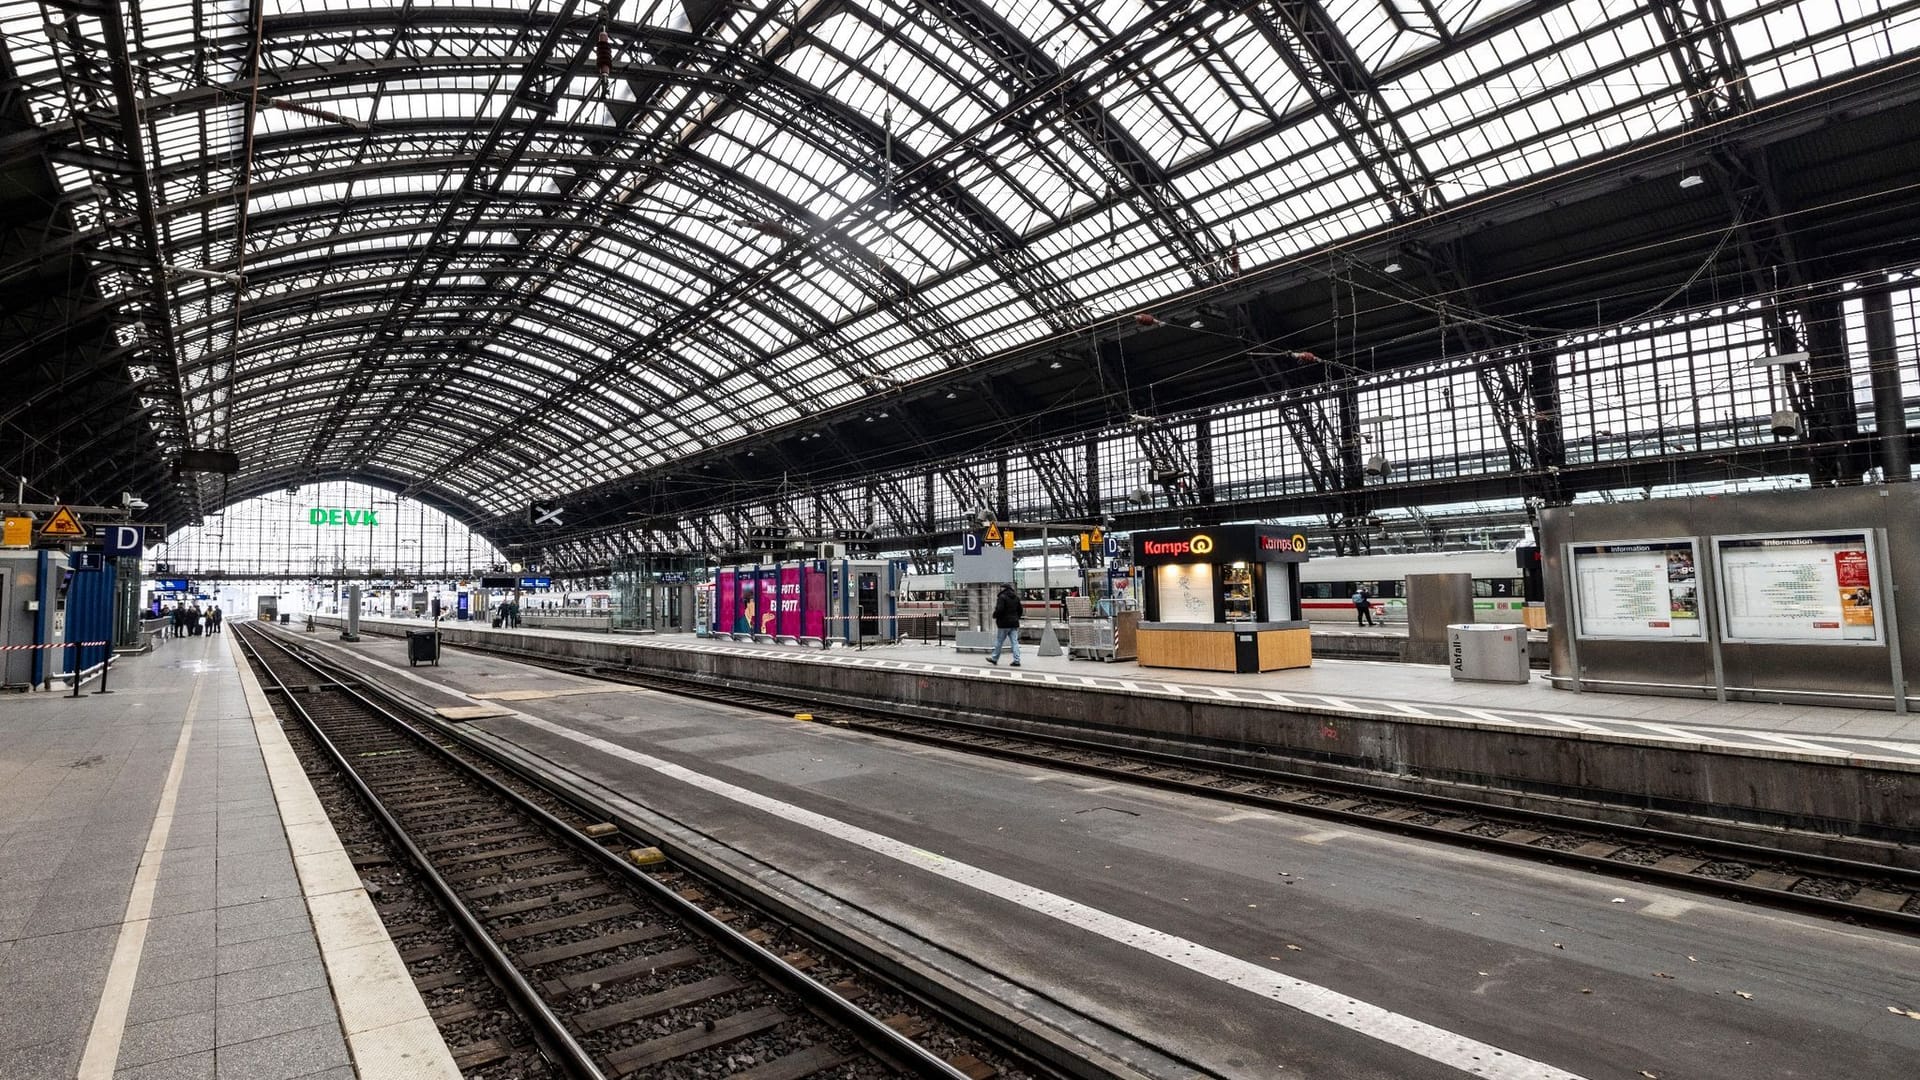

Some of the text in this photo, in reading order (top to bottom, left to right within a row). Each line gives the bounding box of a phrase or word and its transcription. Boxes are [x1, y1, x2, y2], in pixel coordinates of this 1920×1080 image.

[309, 508, 379, 526] DEVK
[116, 526, 140, 550] D
[966, 533, 977, 551] D
[1108, 538, 1117, 553] D
[1260, 534, 1292, 552] Kamps
[1764, 538, 1813, 546] Information
[1144, 540, 1190, 556] Kamps
[1610, 545, 1650, 553] Information
[781, 584, 795, 594] FOTT
[1498, 583, 1506, 592] 2
[1452, 641, 1463, 672] Abfall
